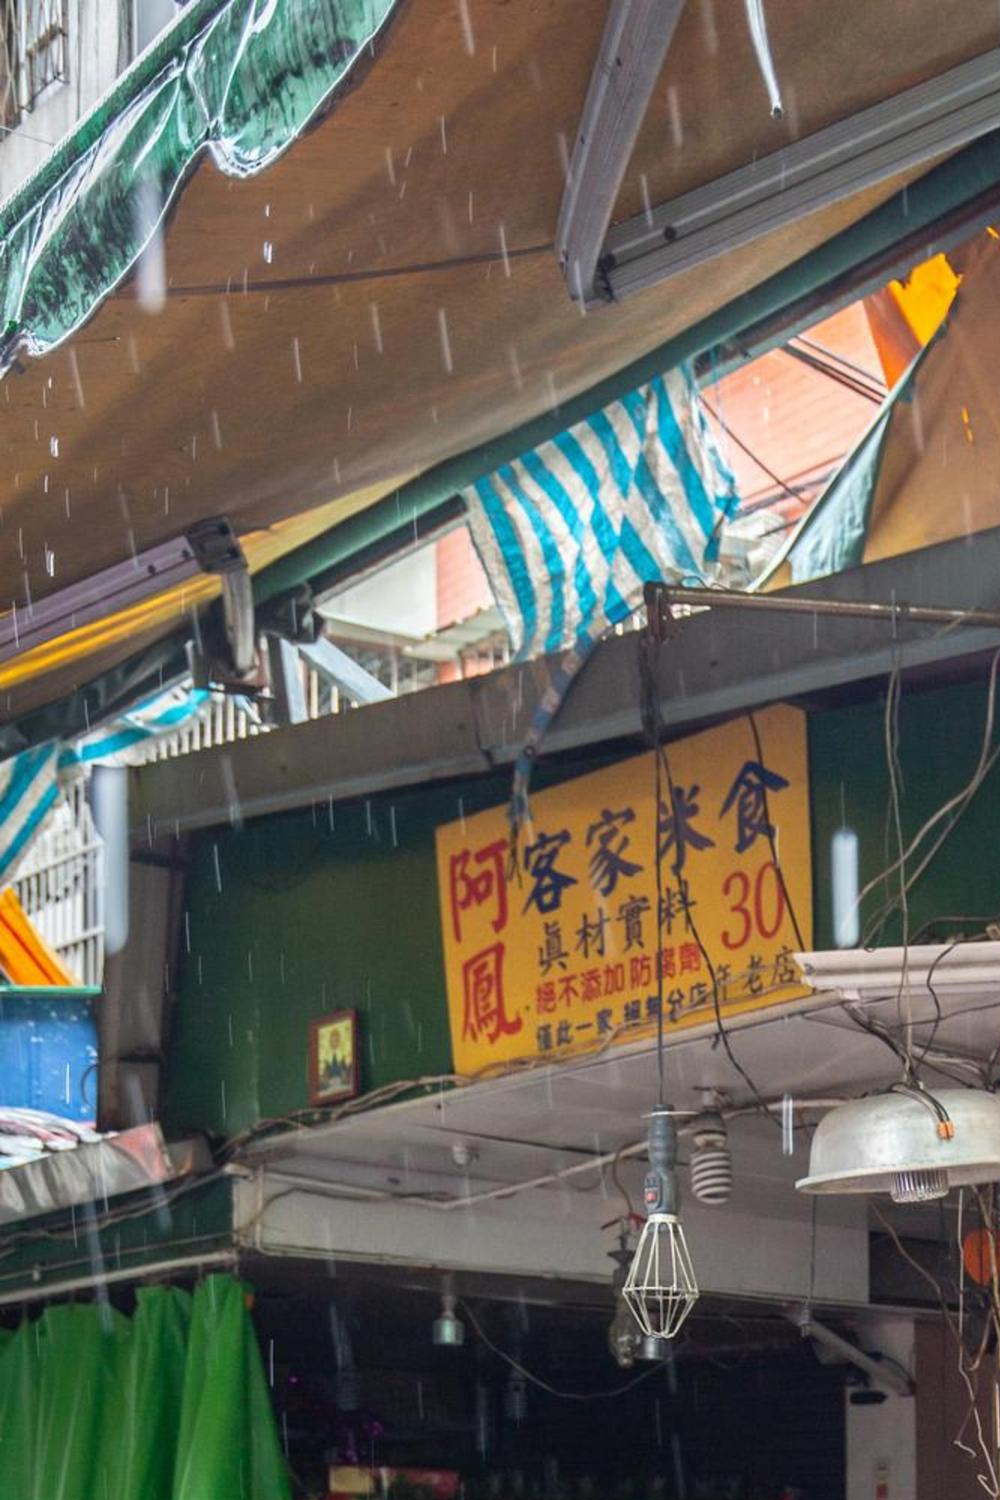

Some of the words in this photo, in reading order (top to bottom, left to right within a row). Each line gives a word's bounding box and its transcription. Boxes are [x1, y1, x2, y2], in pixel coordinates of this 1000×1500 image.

[521, 760, 790, 917] 客家米食
[721, 861, 786, 951] 30
[449, 839, 523, 1045] 阿鳳
